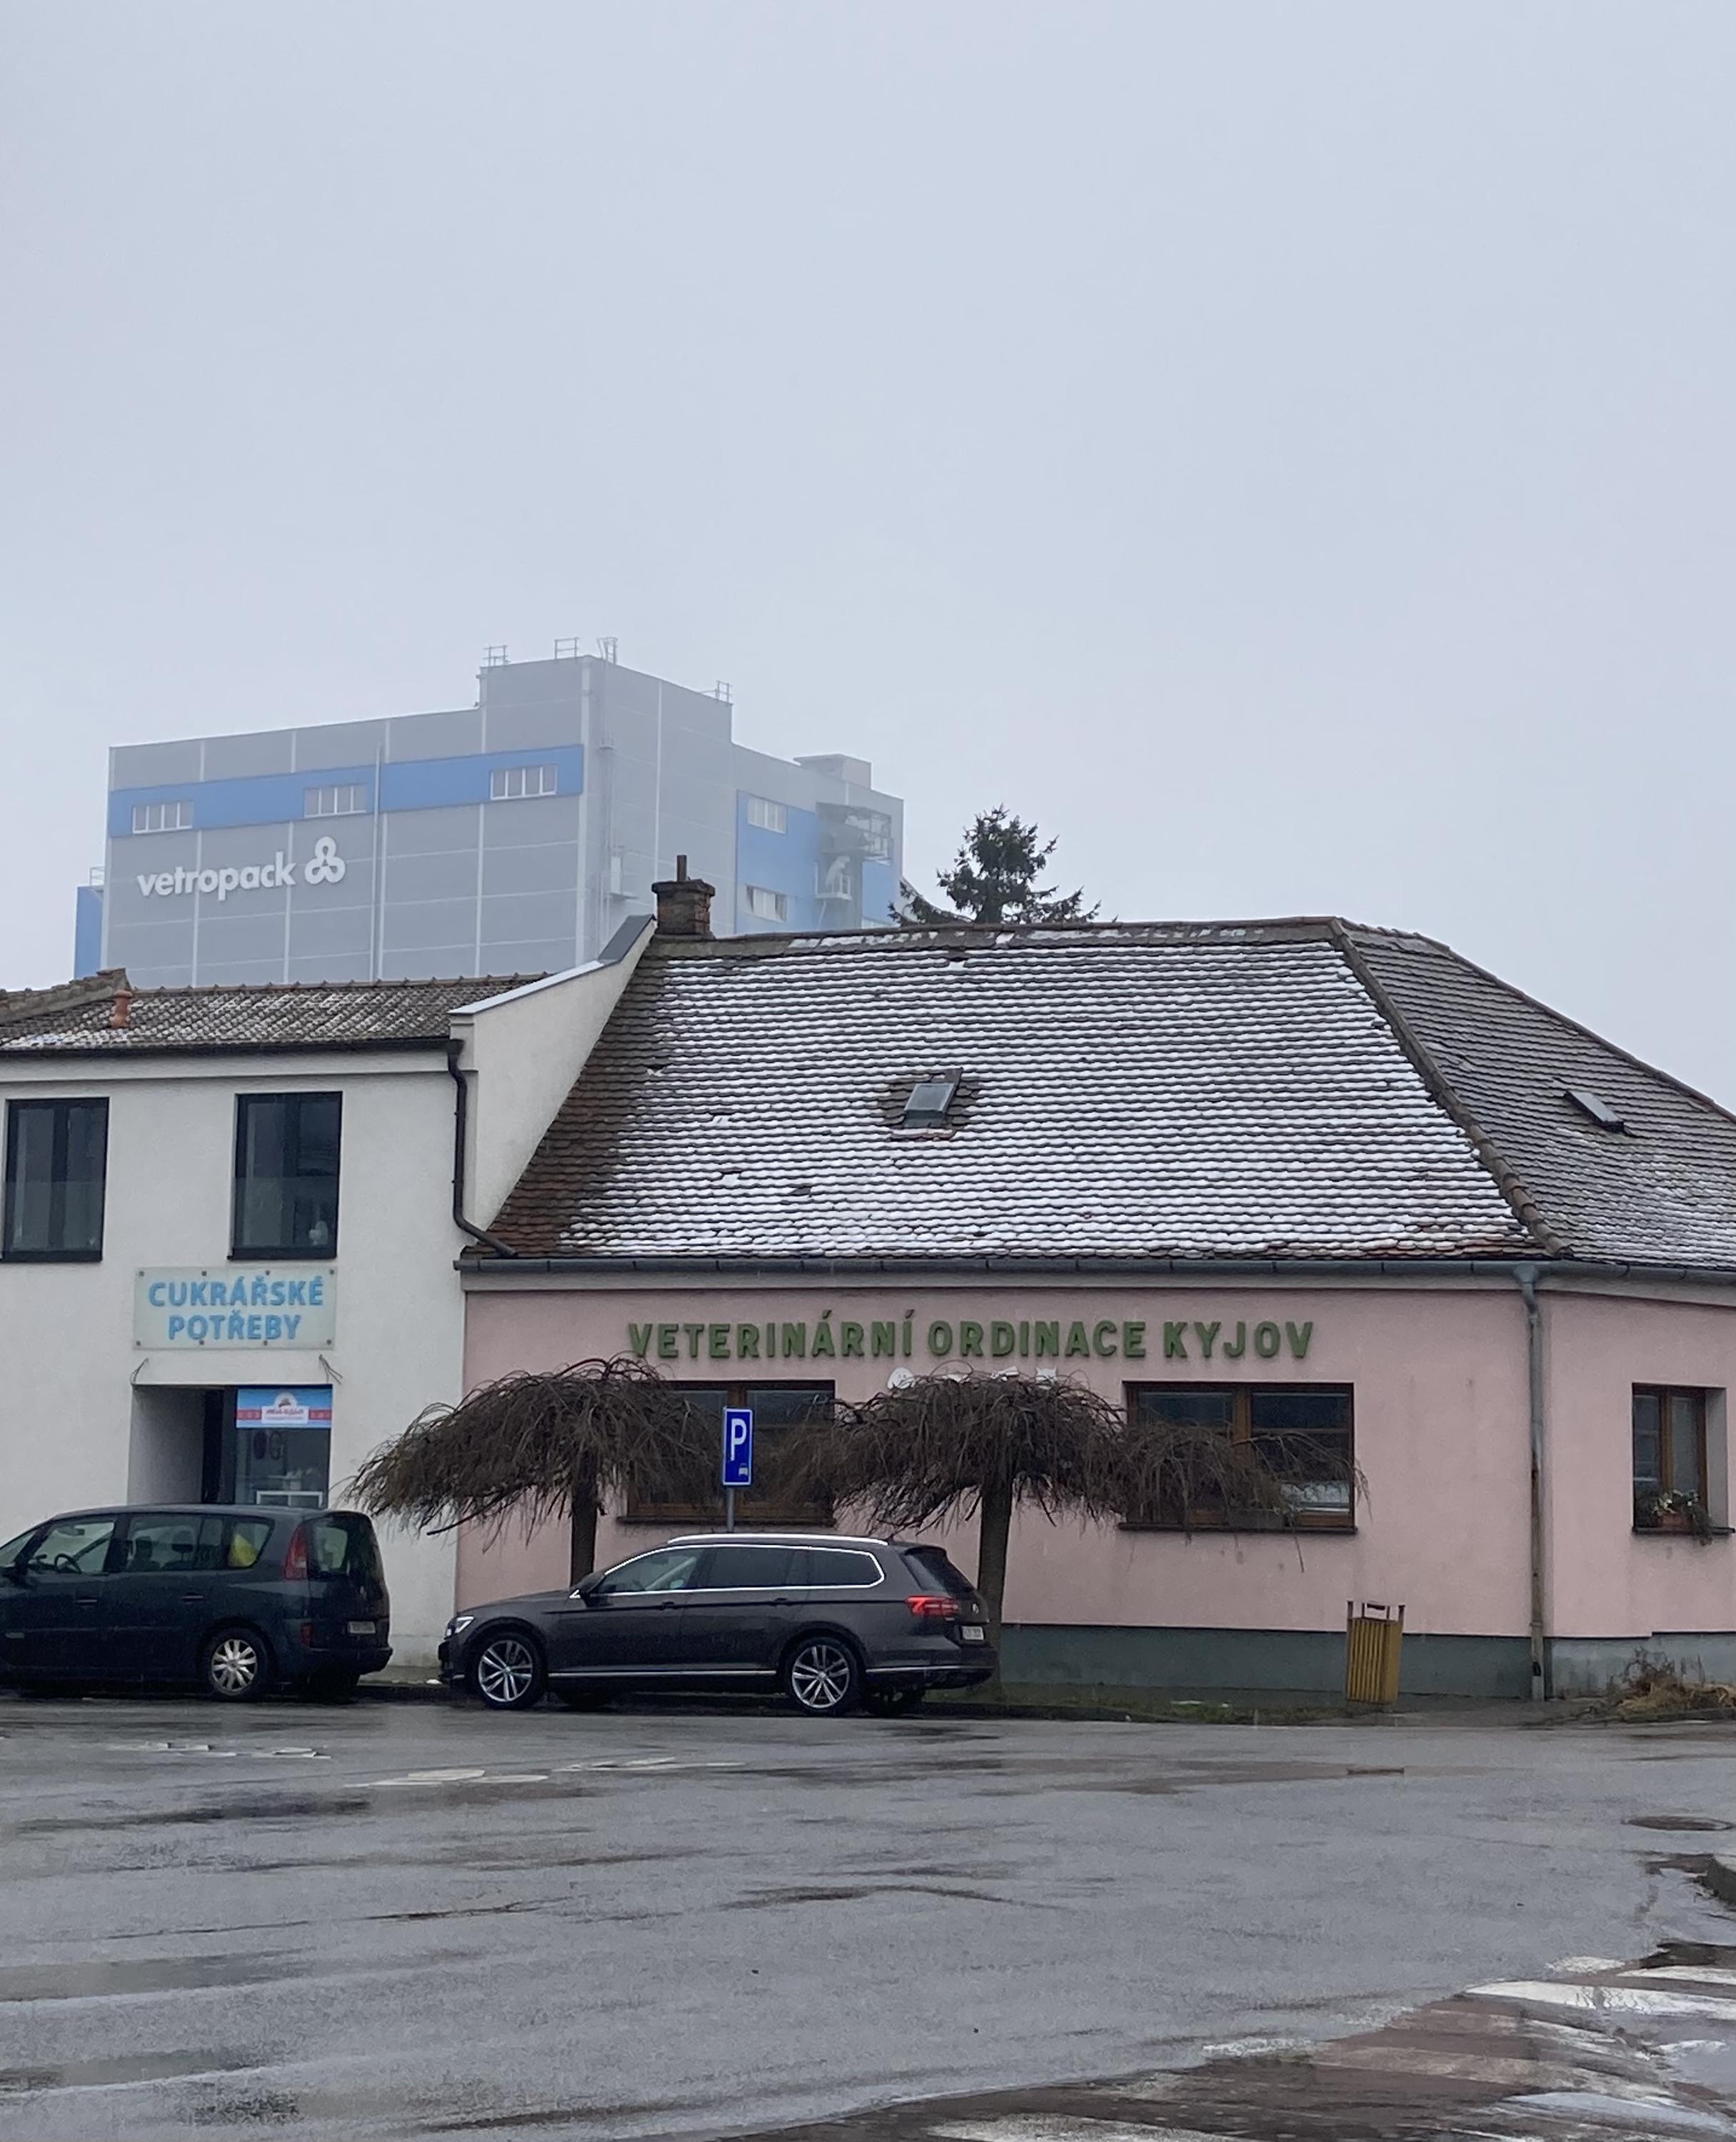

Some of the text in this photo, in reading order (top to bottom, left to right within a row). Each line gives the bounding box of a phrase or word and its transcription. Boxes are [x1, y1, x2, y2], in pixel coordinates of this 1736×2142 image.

[136, 851, 296, 901] vetropack
[148, 1275, 324, 1307] CUKRÁŘSKÉ
[168, 1308, 301, 1341] POTŘEBY
[628, 1309, 1314, 1358] VETERINÁRNÍ ORDINACE KYJOV
[730, 1417, 748, 1462] P
